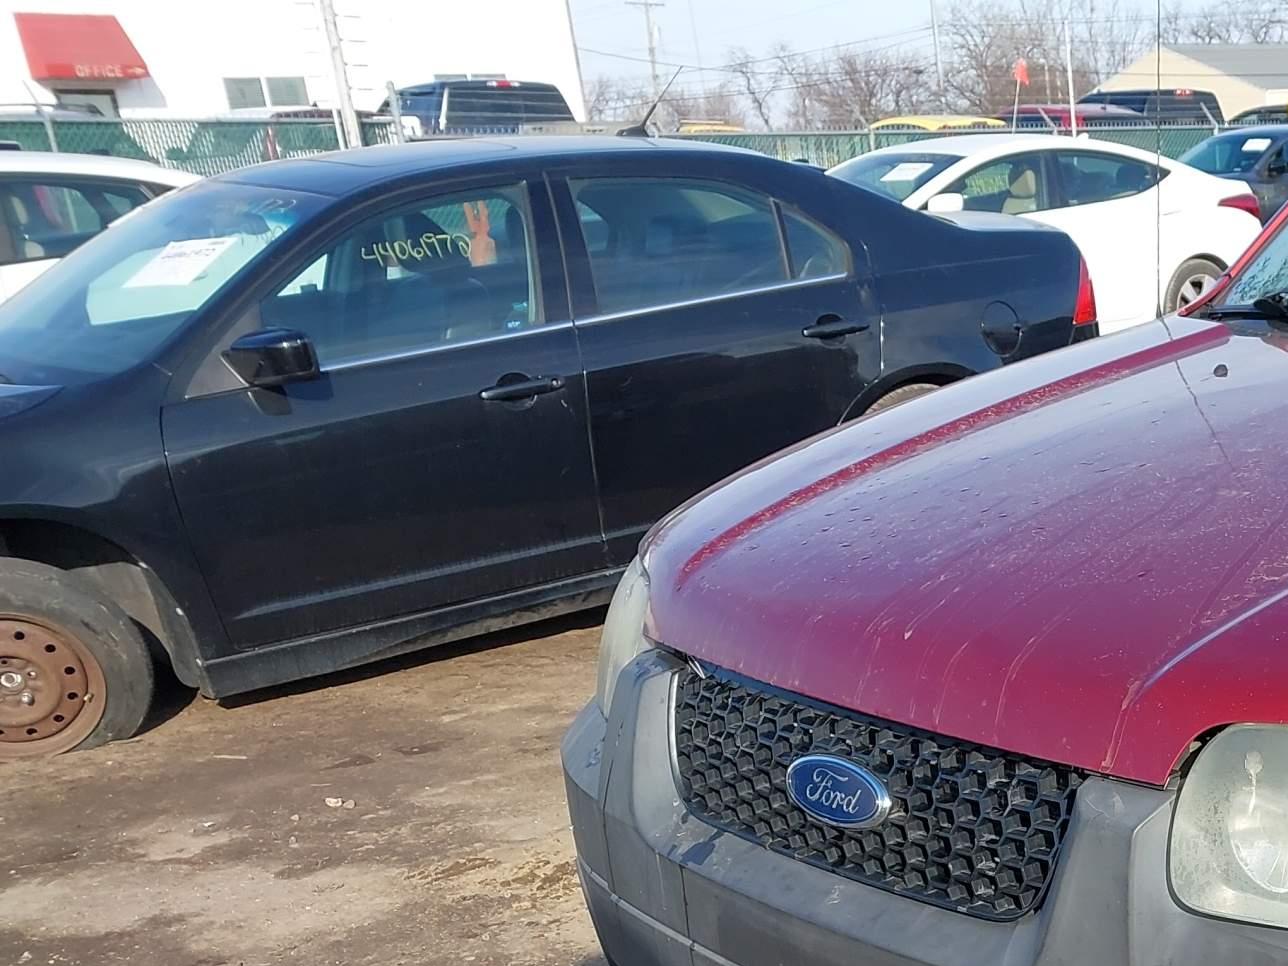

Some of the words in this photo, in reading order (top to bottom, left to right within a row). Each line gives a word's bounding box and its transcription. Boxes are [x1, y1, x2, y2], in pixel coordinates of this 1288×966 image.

[74, 64, 124, 78] OFFICE
[361, 232, 472, 267] 44061972
[806, 767, 862, 814] Ford
